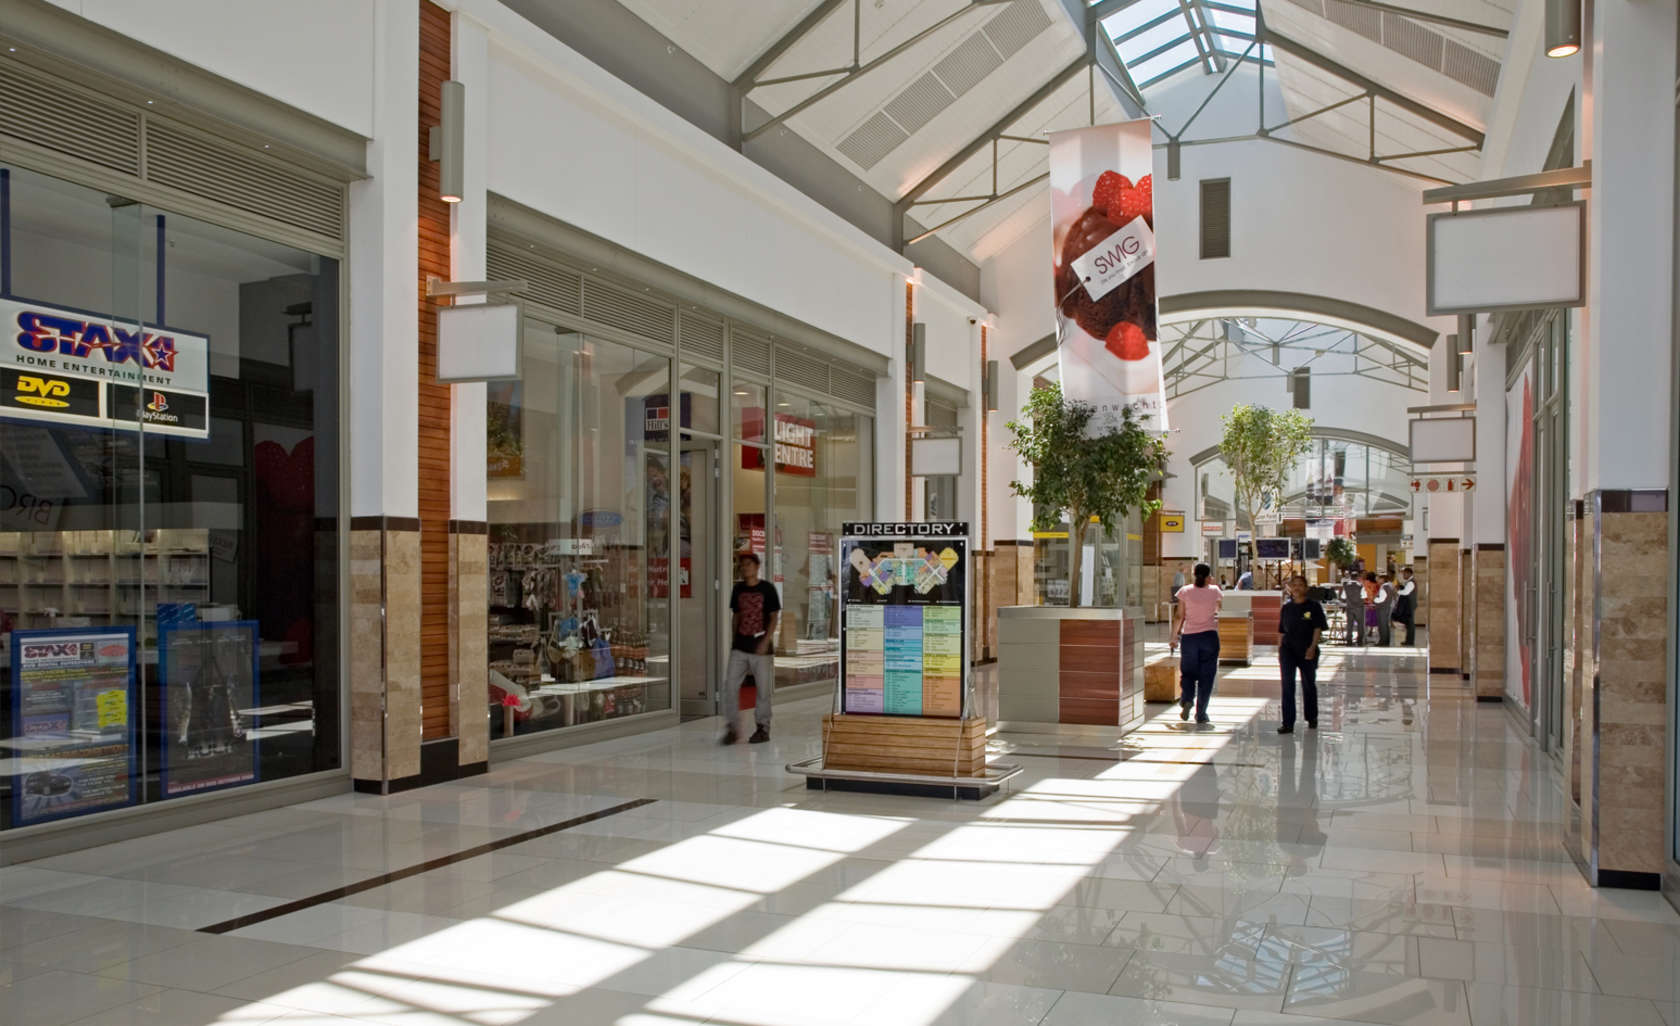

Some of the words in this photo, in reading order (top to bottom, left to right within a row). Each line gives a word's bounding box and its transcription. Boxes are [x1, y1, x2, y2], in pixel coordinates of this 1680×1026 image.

[1094, 236, 1140, 275] SWIG
[16, 354, 57, 368] HOME
[63, 361, 172, 385] ENTERTAINMENT
[17, 375, 71, 397] DVD
[763, 443, 814, 469] ENTRE
[854, 523, 955, 535] DIRECTORY
